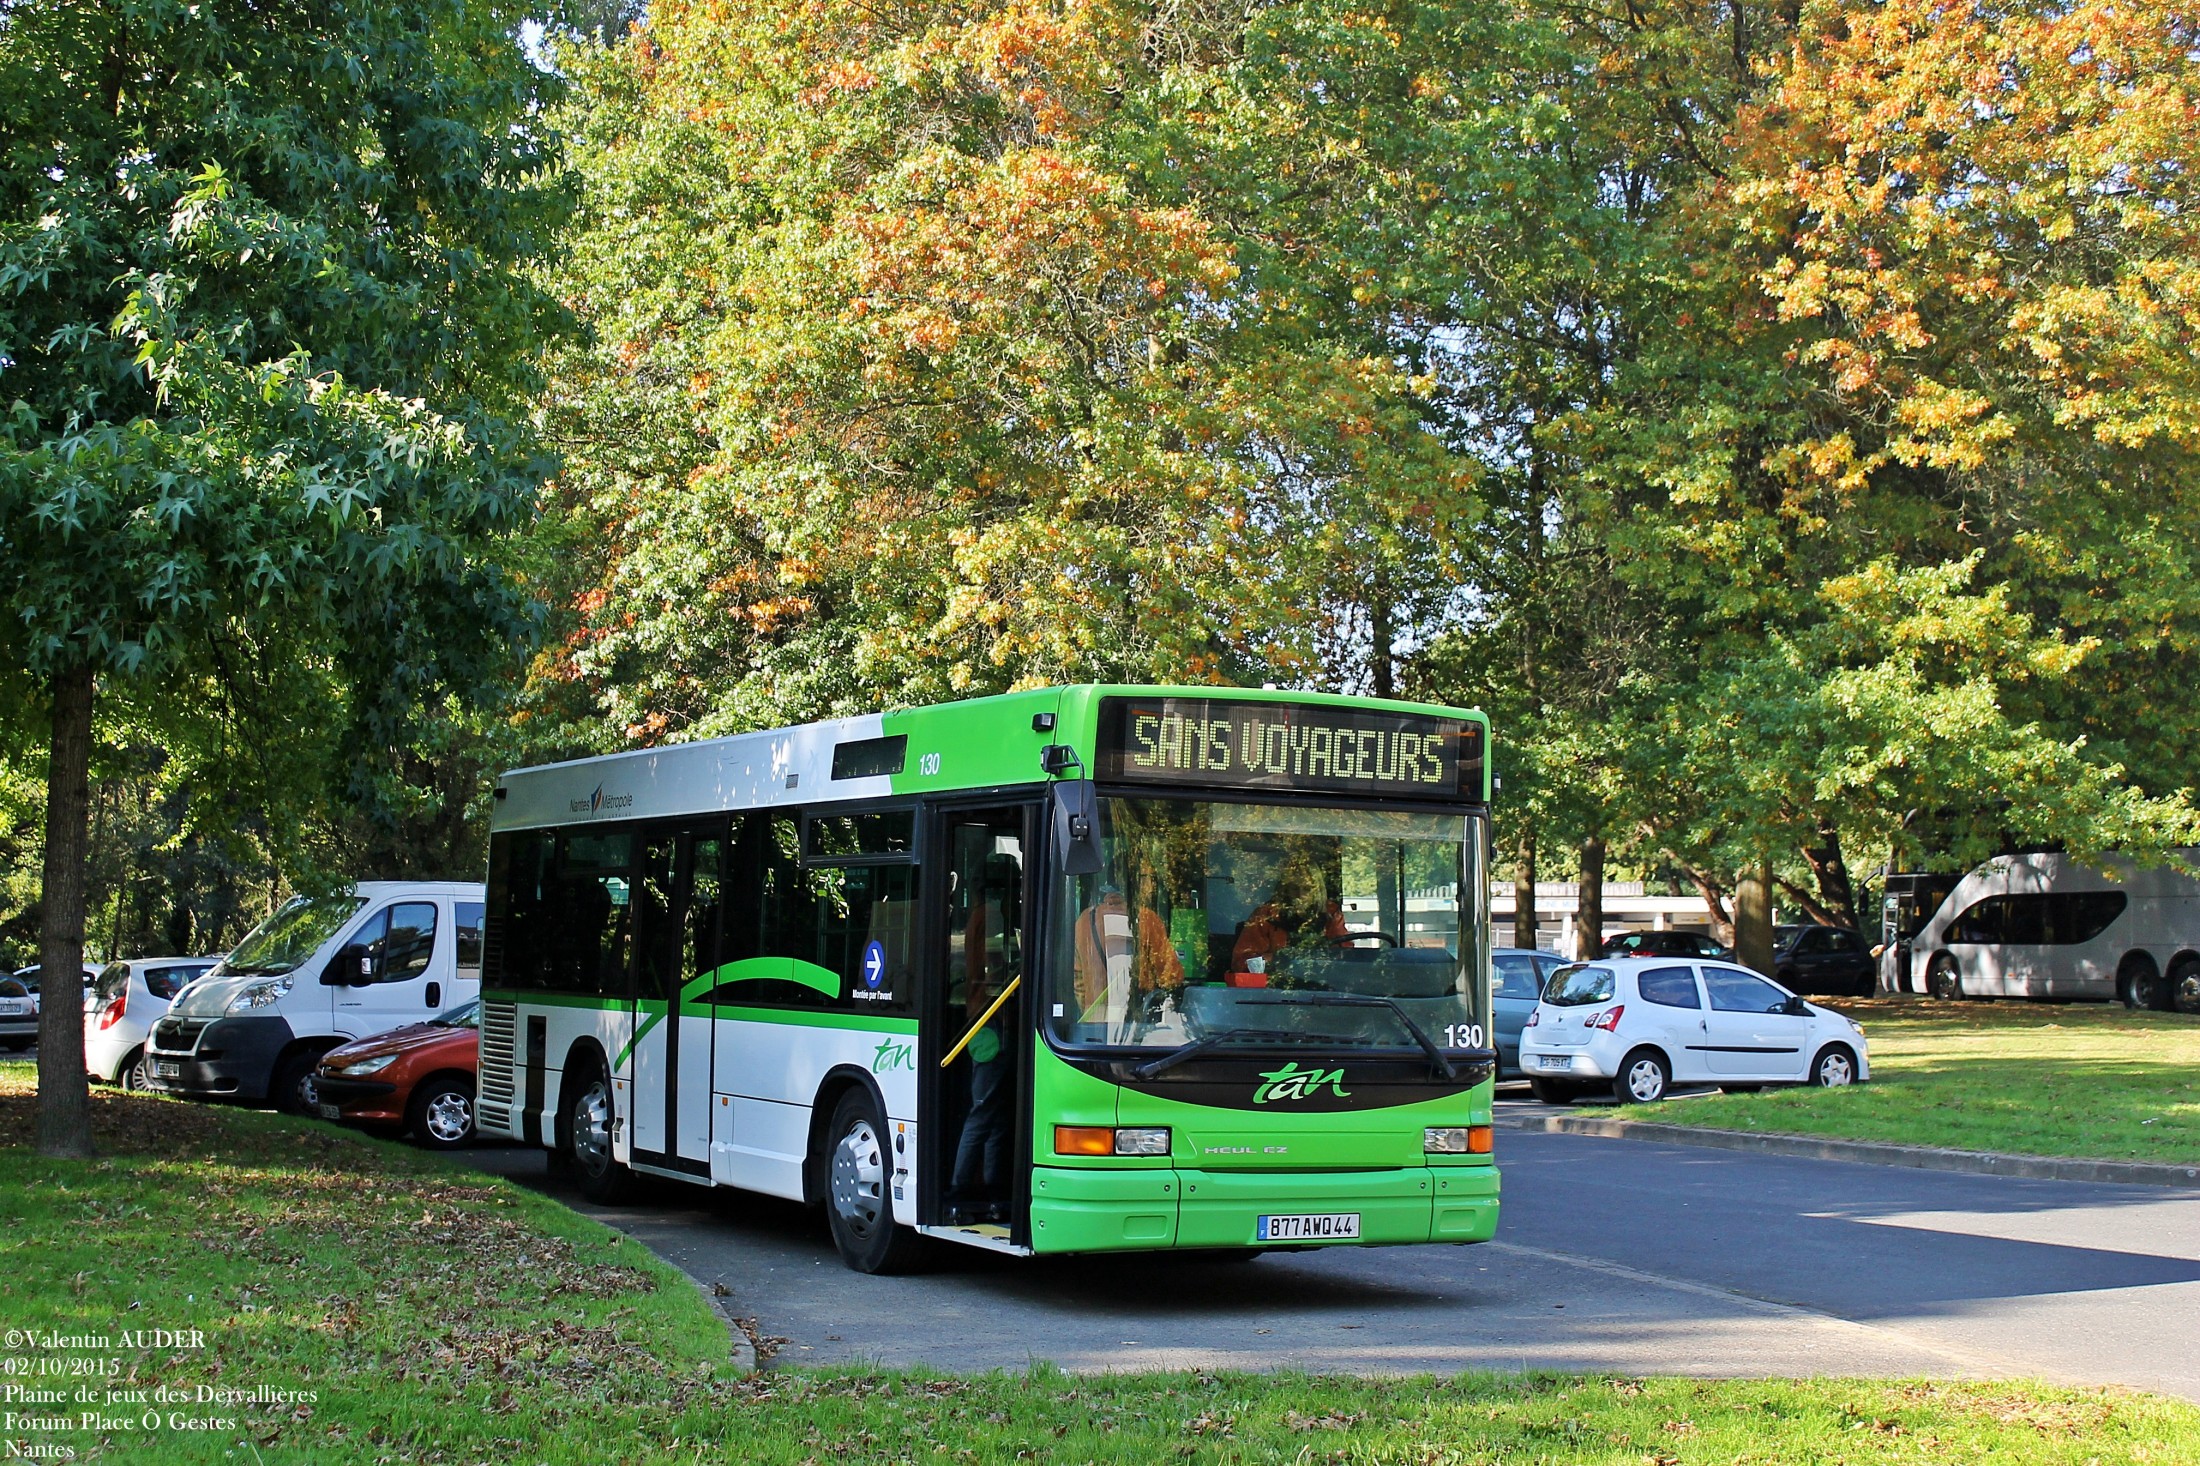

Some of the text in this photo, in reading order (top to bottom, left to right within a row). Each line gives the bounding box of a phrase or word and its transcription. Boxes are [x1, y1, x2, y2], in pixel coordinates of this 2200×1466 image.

[1134, 715, 1444, 783] SANS VOYAGEURS
[919, 752, 940, 776] 130
[569, 799, 590, 812] Nantes
[868, 991, 877, 1001] par
[1444, 1024, 1484, 1049] 130
[873, 1037, 916, 1074] tan
[1252, 1062, 1352, 1104] tan
